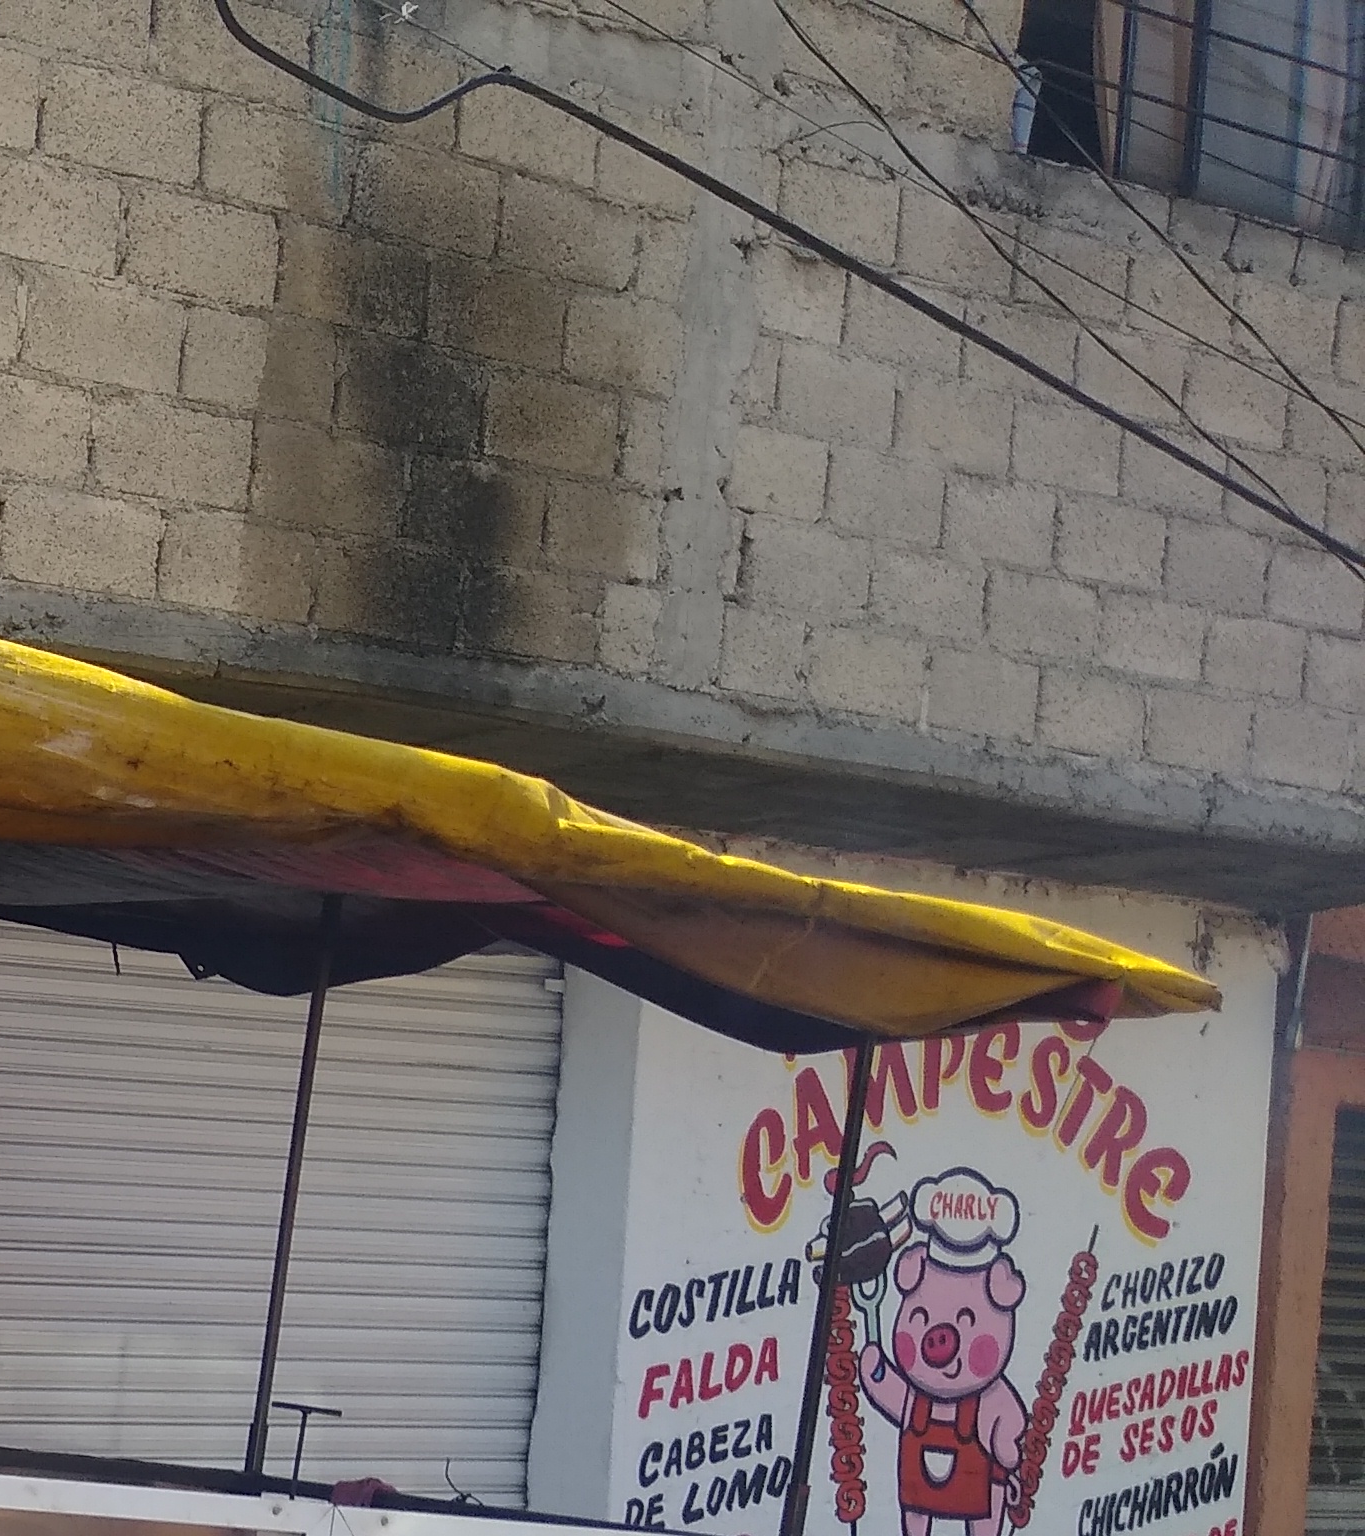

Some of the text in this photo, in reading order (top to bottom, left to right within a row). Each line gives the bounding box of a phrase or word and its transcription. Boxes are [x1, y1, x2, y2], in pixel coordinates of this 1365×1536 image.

[741, 1020, 1192, 1242] CAMPESTRE
[929, 1190, 1000, 1221] CHARLY
[628, 1257, 802, 1339] COSTILLA
[1100, 1252, 1226, 1312] CHORIZO
[1082, 1295, 1239, 1363] ARGENTINO
[637, 1337, 779, 1420] FALDA
[1068, 1349, 1250, 1437] QUESADILLAS
[638, 1413, 773, 1488] CABEZA
[1061, 1398, 1219, 1478] DE SESOS
[624, 1455, 792, 1529] DE LOMO
